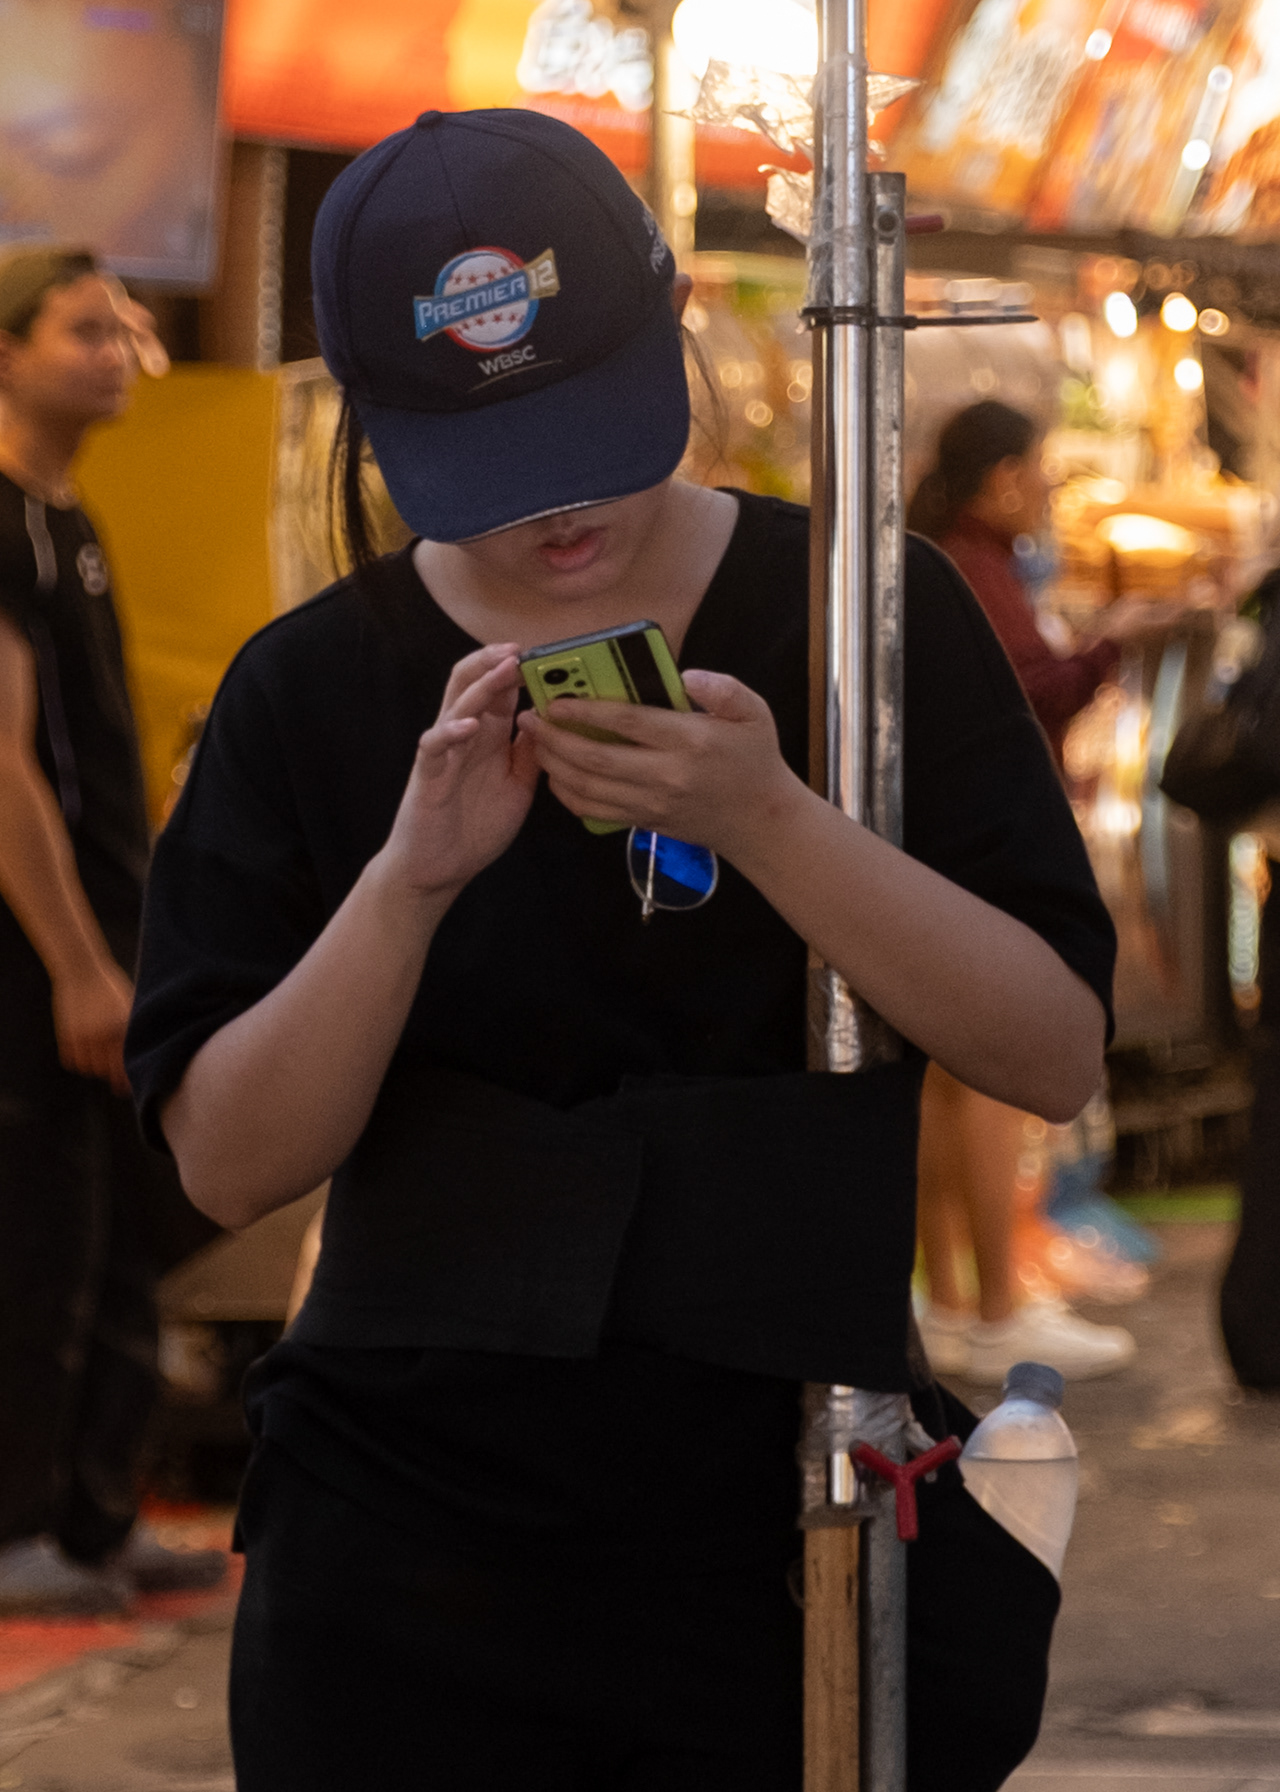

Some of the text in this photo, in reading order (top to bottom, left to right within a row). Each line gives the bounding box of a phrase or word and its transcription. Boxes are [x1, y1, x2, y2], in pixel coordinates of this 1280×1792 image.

[419, 259, 557, 328] PREMIER 12
[478, 345, 537, 376] WBSC
